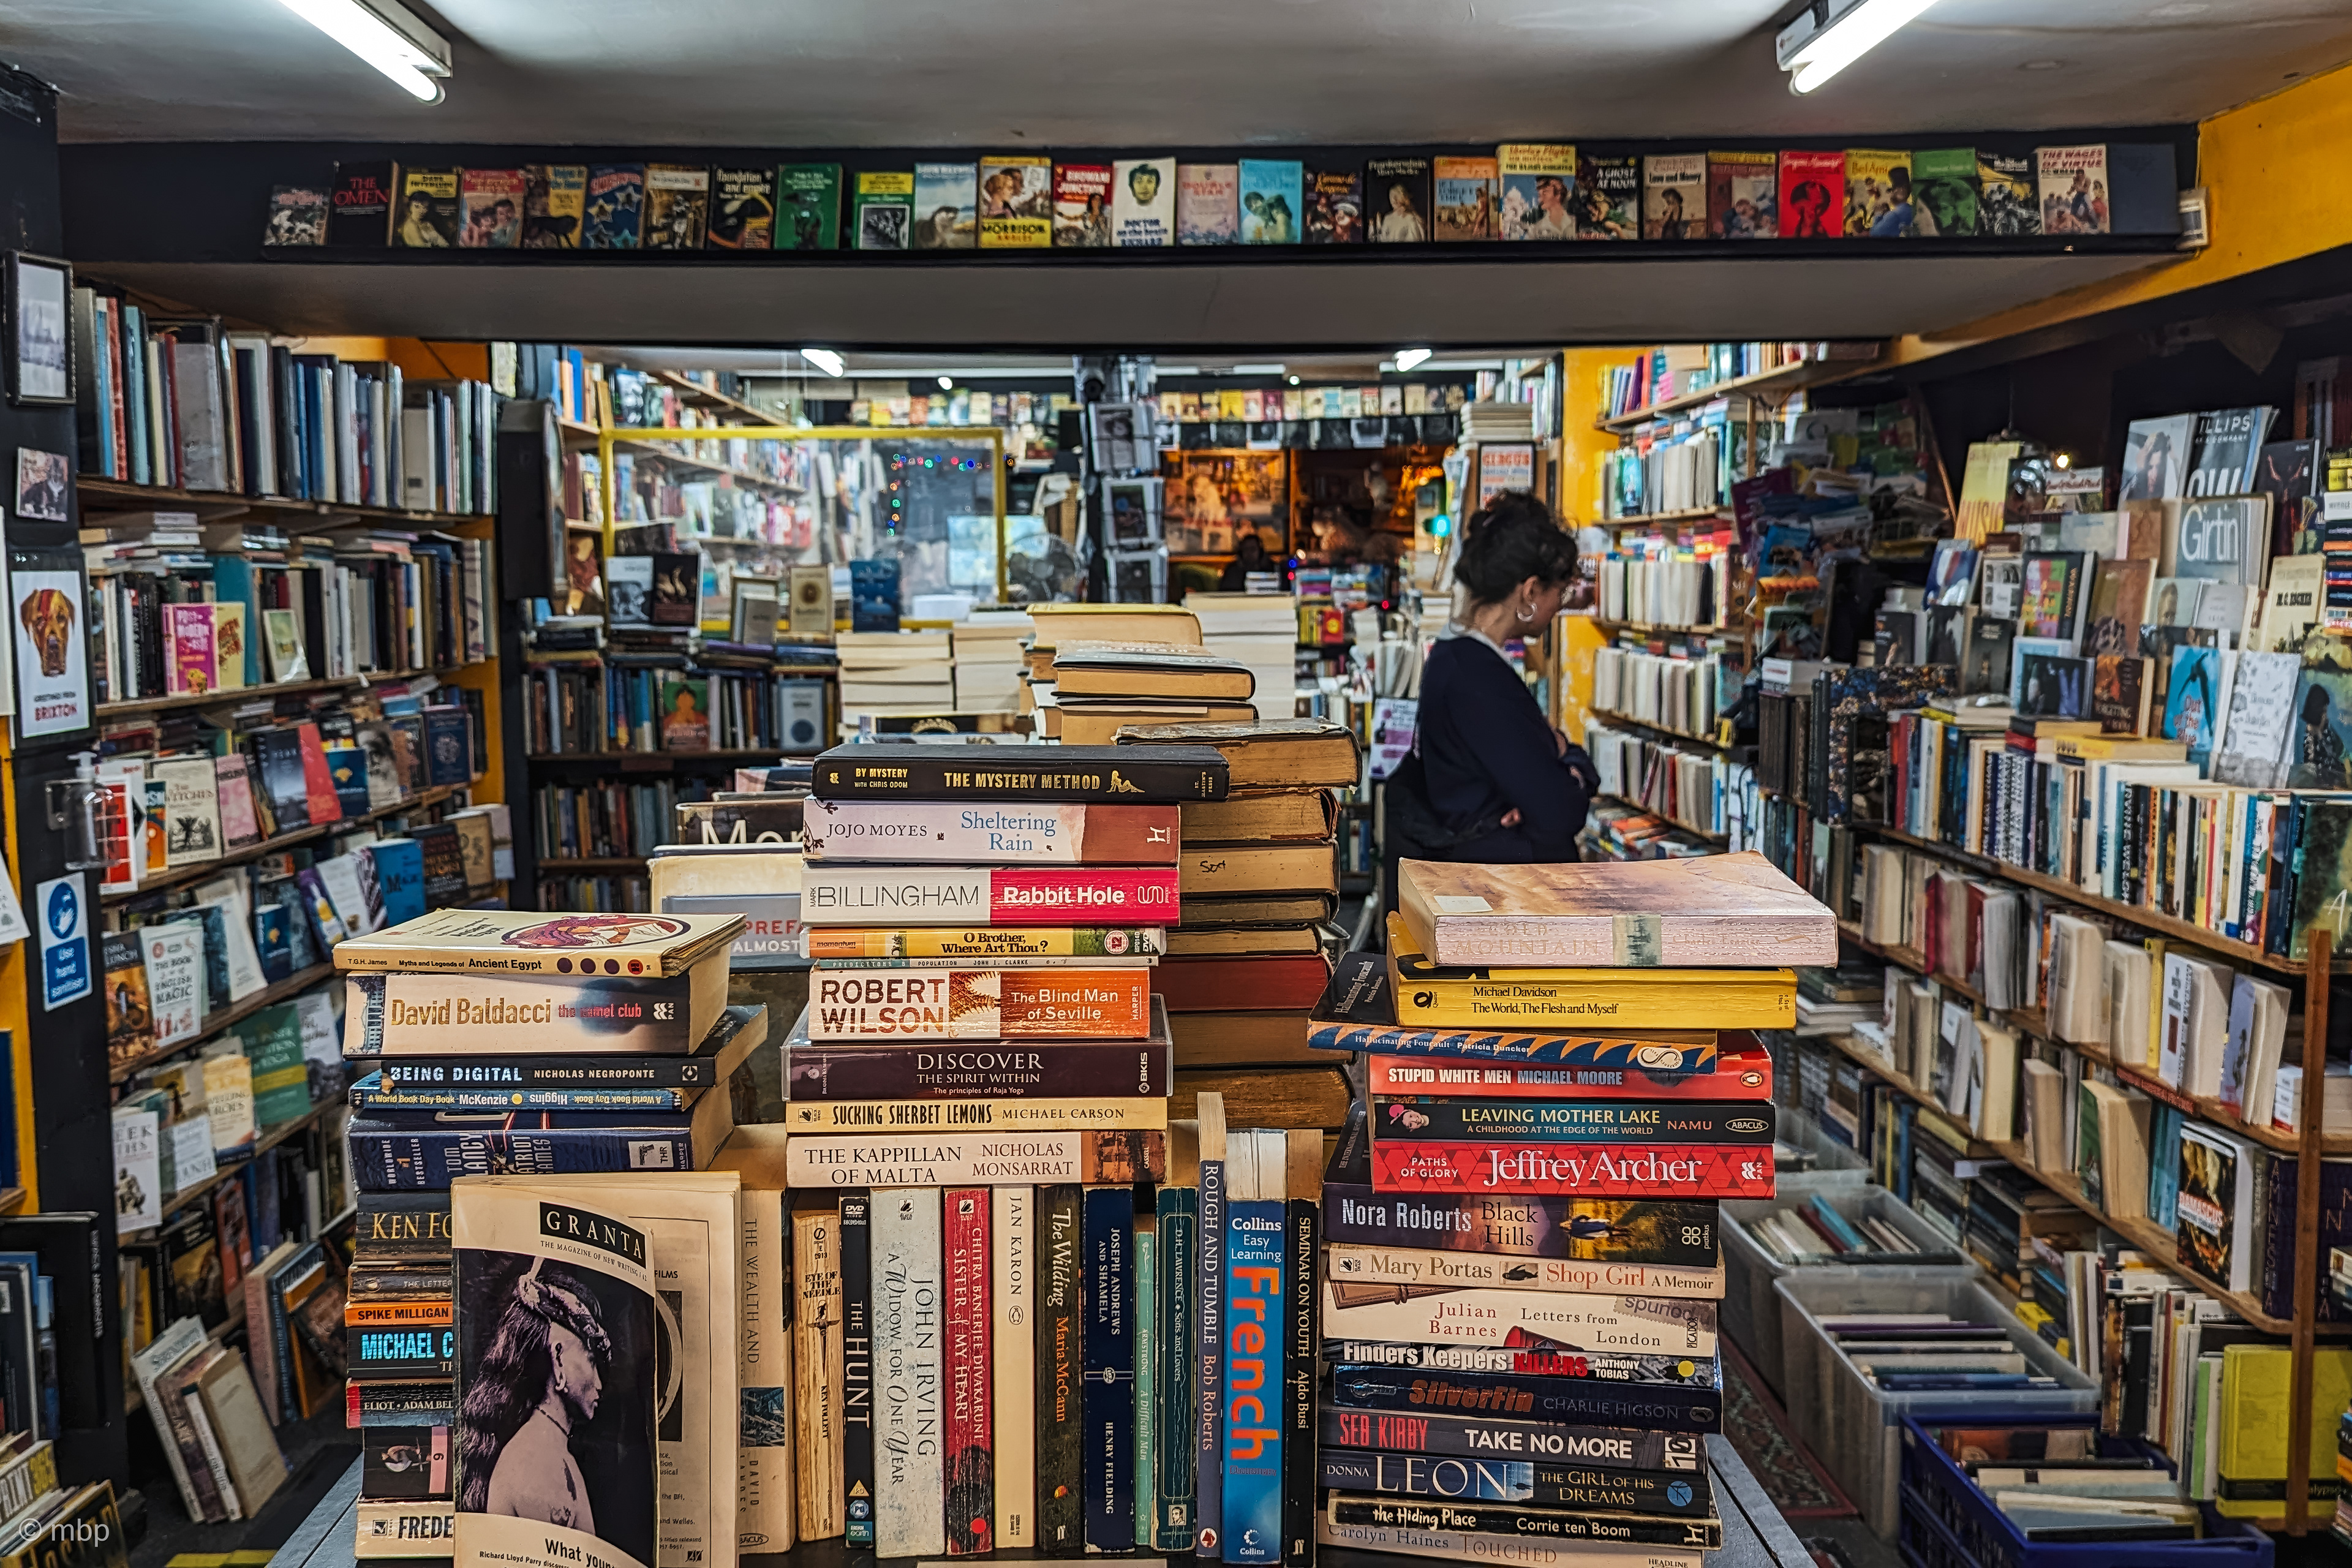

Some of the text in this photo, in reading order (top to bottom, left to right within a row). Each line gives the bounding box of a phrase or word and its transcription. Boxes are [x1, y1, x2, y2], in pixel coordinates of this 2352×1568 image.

[349, 177, 377, 189] THE
[334, 189, 388, 206] OMEN
[2181, 503, 2238, 562] Girtin
[856, 768, 908, 778] BY MYSTERY
[944, 772, 1100, 790] THE MYSTERY METHOD
[827, 824, 927, 838] JOJO MOYES
[962, 811, 1057, 836] Sheltering
[989, 833, 1033, 851] Rain
[818, 886, 978, 907] BILLINGHAM
[1005, 887, 1124, 905] Rabbit Hole
[732, 940, 799, 952] ALMOST
[469, 958, 542, 970] Ancient Egypt
[821, 979, 945, 1005] ROBERT
[1012, 989, 1118, 1004] The Blind Man
[1473, 987, 1556, 997] Michael Davidson
[391, 998, 551, 1025] David Baldacci
[821, 1007, 945, 1034] WILSON
[1027, 1006, 1101, 1020] of Seville
[918, 1053, 1044, 1070] DISCOVER
[1140, 1052, 1148, 1081] BKIS
[390, 1068, 655, 1082] BEING DIGITAL NICHOLAS NEGROPONTE
[918, 1072, 1040, 1083] THE SPIRIT WITHIN
[1389, 1068, 1510, 1084] STUPID WHITE MEN
[1517, 1070, 1623, 1085] MICHAEL MOORE
[459, 1095, 508, 1105] McKenzie
[834, 1104, 1125, 1125] SUCKING SHERBET LEMONS MICHAEL CARSON
[1463, 1109, 1660, 1124] LEAVING MOTHER LAKE
[1667, 1120, 1712, 1130] NAMU
[1732, 1121, 1763, 1130] ABACUS
[804, 1146, 961, 1164] THE KAPPILLAN
[981, 1143, 1063, 1157] NICHOLAS
[831, 1168, 937, 1185] OF MALTA
[973, 1161, 1073, 1177] MONSARRAT
[1483, 1149, 1702, 1187] Jeffrey Archer
[1342, 1199, 1471, 1232] Nora Roberts
[1481, 1202, 1539, 1223] Black
[371, 1213, 420, 1240] KEN
[1232, 1218, 1281, 1232] Collins
[547, 1211, 642, 1259] GRANTA
[1244, 1235, 1270, 1249] Easy
[1486, 1225, 1534, 1246] Hills
[540, 1240, 554, 1249] THE
[557, 1244, 591, 1256] MAGAZINE
[603, 1256, 615, 1265] NEW
[1009, 1197, 1021, 1295] JAN KARON
[1231, 1248, 1281, 1262] Learning
[1047, 1208, 1071, 1306] The Wilding
[654, 1270, 678, 1278] FILMS
[1370, 1254, 1492, 1281] Mary Portas
[1547, 1263, 1714, 1289] Shop Girl Memoir
[745, 1219, 760, 1363] THE WEALTH AND
[1111, 1229, 1120, 1335] JOSEPH ANDREWS
[358, 1308, 448, 1320] SPIKE MILLIGAN
[1202, 1164, 1218, 1451] ROUGH AND TUMBLE Bob Roberts
[1434, 1302, 1496, 1319] Julian
[1520, 1308, 1618, 1325] Letters from
[1297, 1217, 1310, 1429] SEMINAR ON YOUTH Aldo Busi
[1429, 1320, 1496, 1337] Barnes
[1596, 1330, 1661, 1346] London
[1687, 1317, 1697, 1348] PICADOR
[361, 1332, 435, 1360] MICHAEL
[845, 1301, 870, 1428] THE HUNT
[1231, 1265, 1280, 1461] French
[1344, 1341, 1418, 1365] Finders
[1423, 1347, 1507, 1371] Keepers
[1595, 1359, 1640, 1370] ANTHONY
[911, 1278, 936, 1456] JOHN IRVING
[1055, 1317, 1069, 1422] Maria McCann
[1595, 1368, 1629, 1379] TOBIAS
[1409, 1380, 1678, 1420] SilverFin CHARLIE HIGSON
[1339, 1414, 1431, 1450] SEB KIRBY
[1327, 1457, 1508, 1498] DONNA LEON
[1517, 1518, 1630, 1537] Corrie ten Boom
[545, 1539, 582, 1562] What
